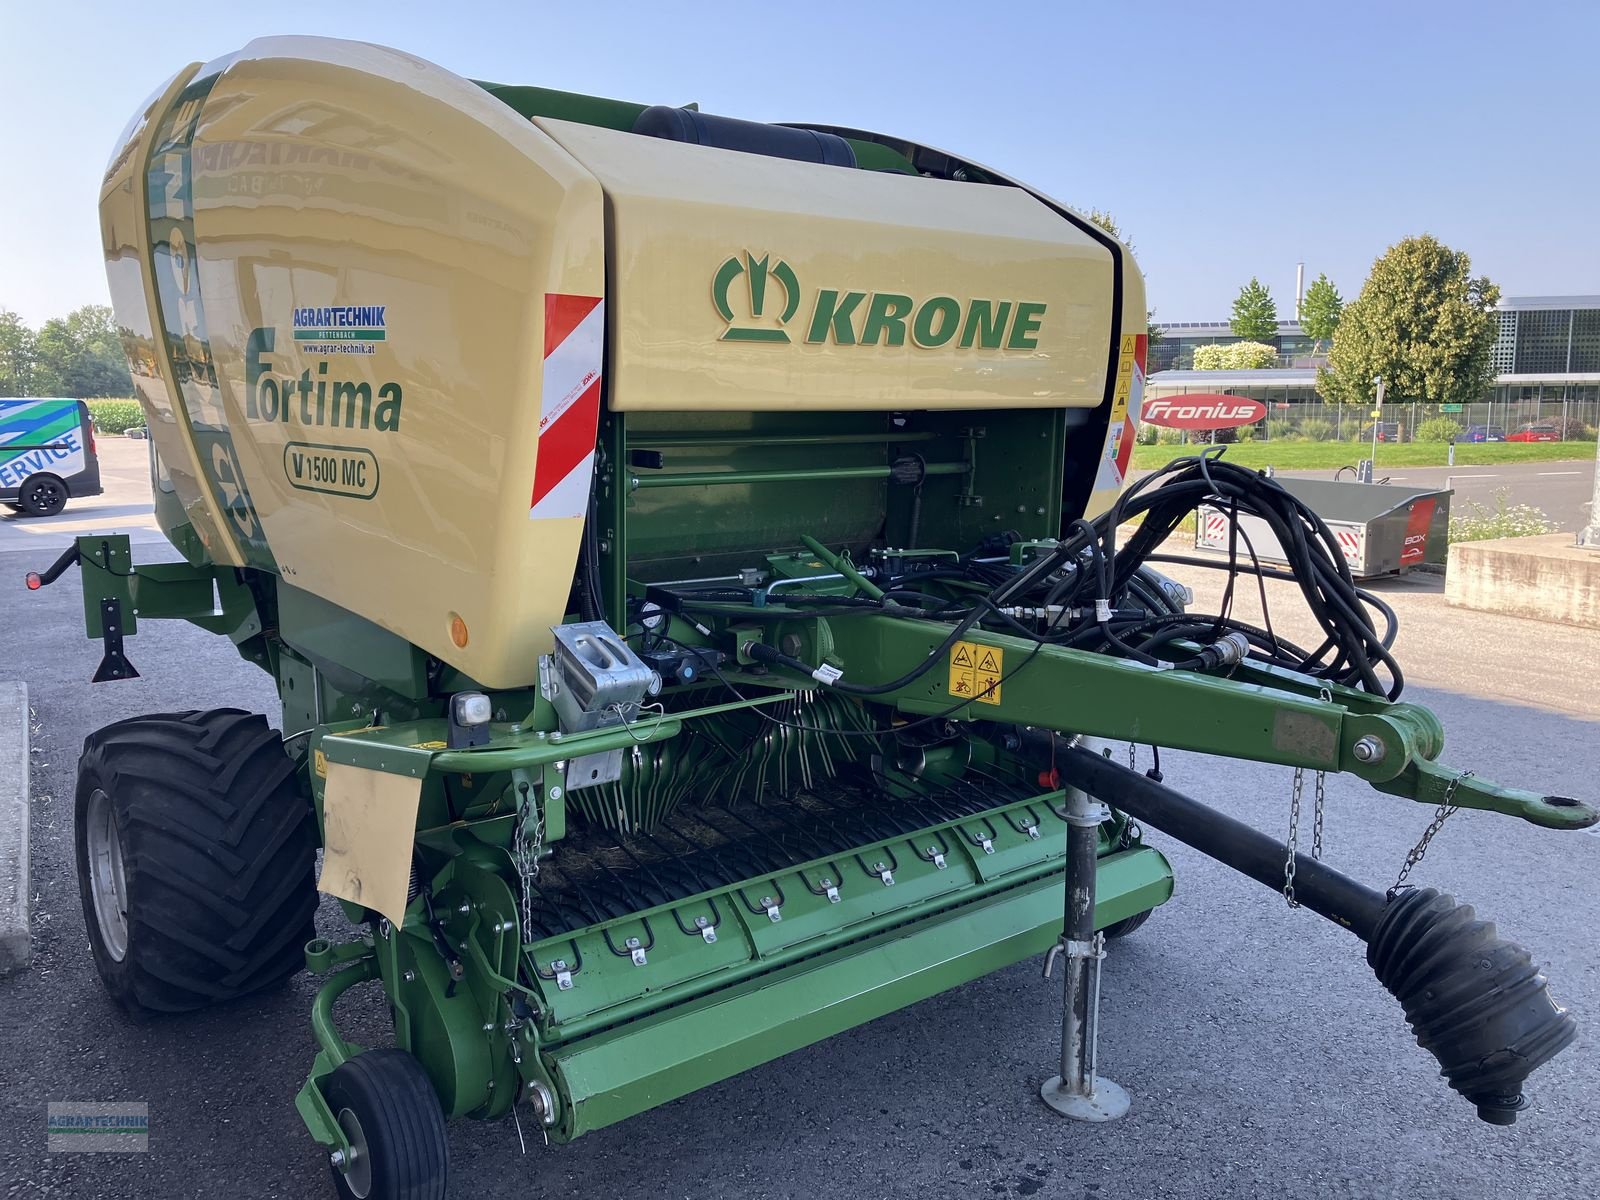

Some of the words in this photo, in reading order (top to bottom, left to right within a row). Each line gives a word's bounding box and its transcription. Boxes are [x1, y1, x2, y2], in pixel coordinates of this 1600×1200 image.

[293, 306, 386, 327] AGRARTECHNIK
[803, 285, 1048, 351] KRONE
[318, 331, 356, 340] PETTENBACH
[303, 343, 375, 355] www.agrar-technik.at
[245, 326, 403, 433] Fortima
[1144, 401, 1257, 420] Fronius
[292, 452, 304, 479] V
[306, 456, 337, 484] 1500
[342, 458, 366, 488] MC
[1404, 533, 1427, 546] BOX
